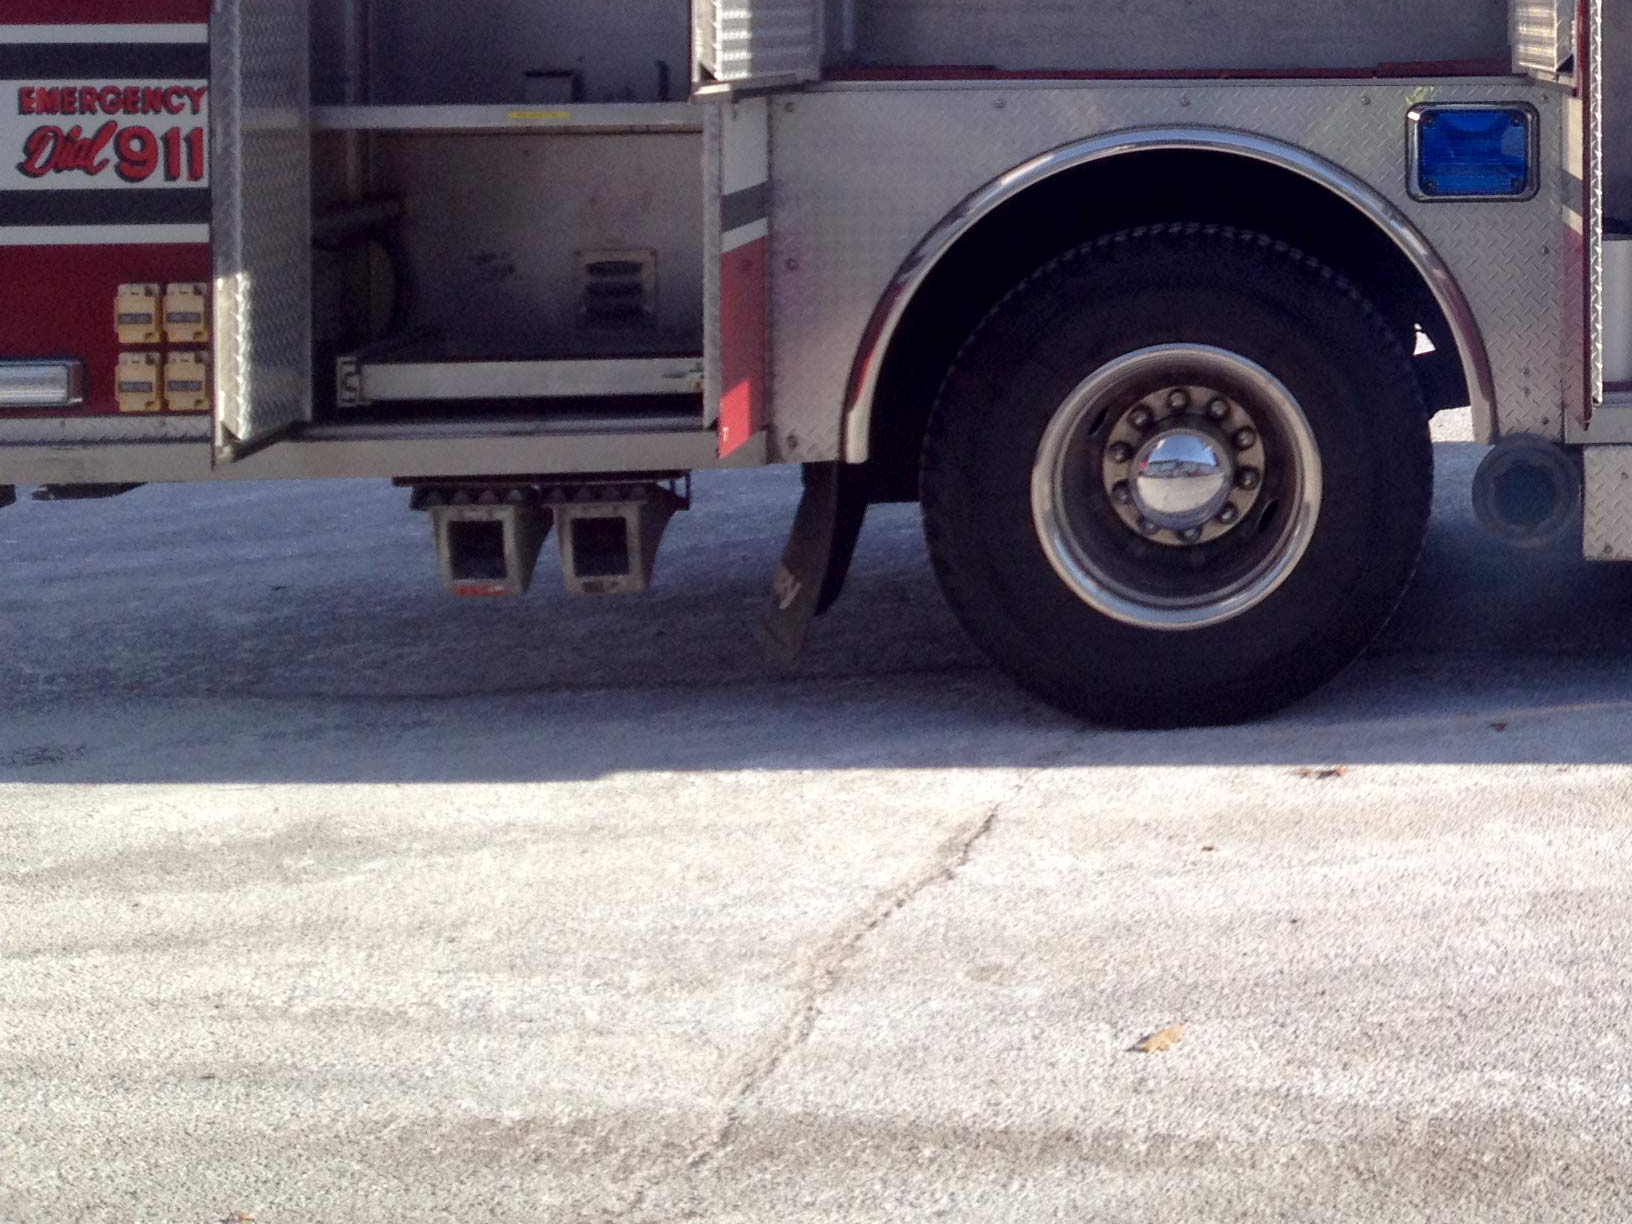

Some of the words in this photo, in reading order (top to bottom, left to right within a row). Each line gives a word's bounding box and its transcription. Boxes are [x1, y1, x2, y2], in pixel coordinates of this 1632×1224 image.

[19, 85, 208, 115] EMERGENCY
[17, 119, 118, 178] Dial
[114, 125, 204, 183] 911
